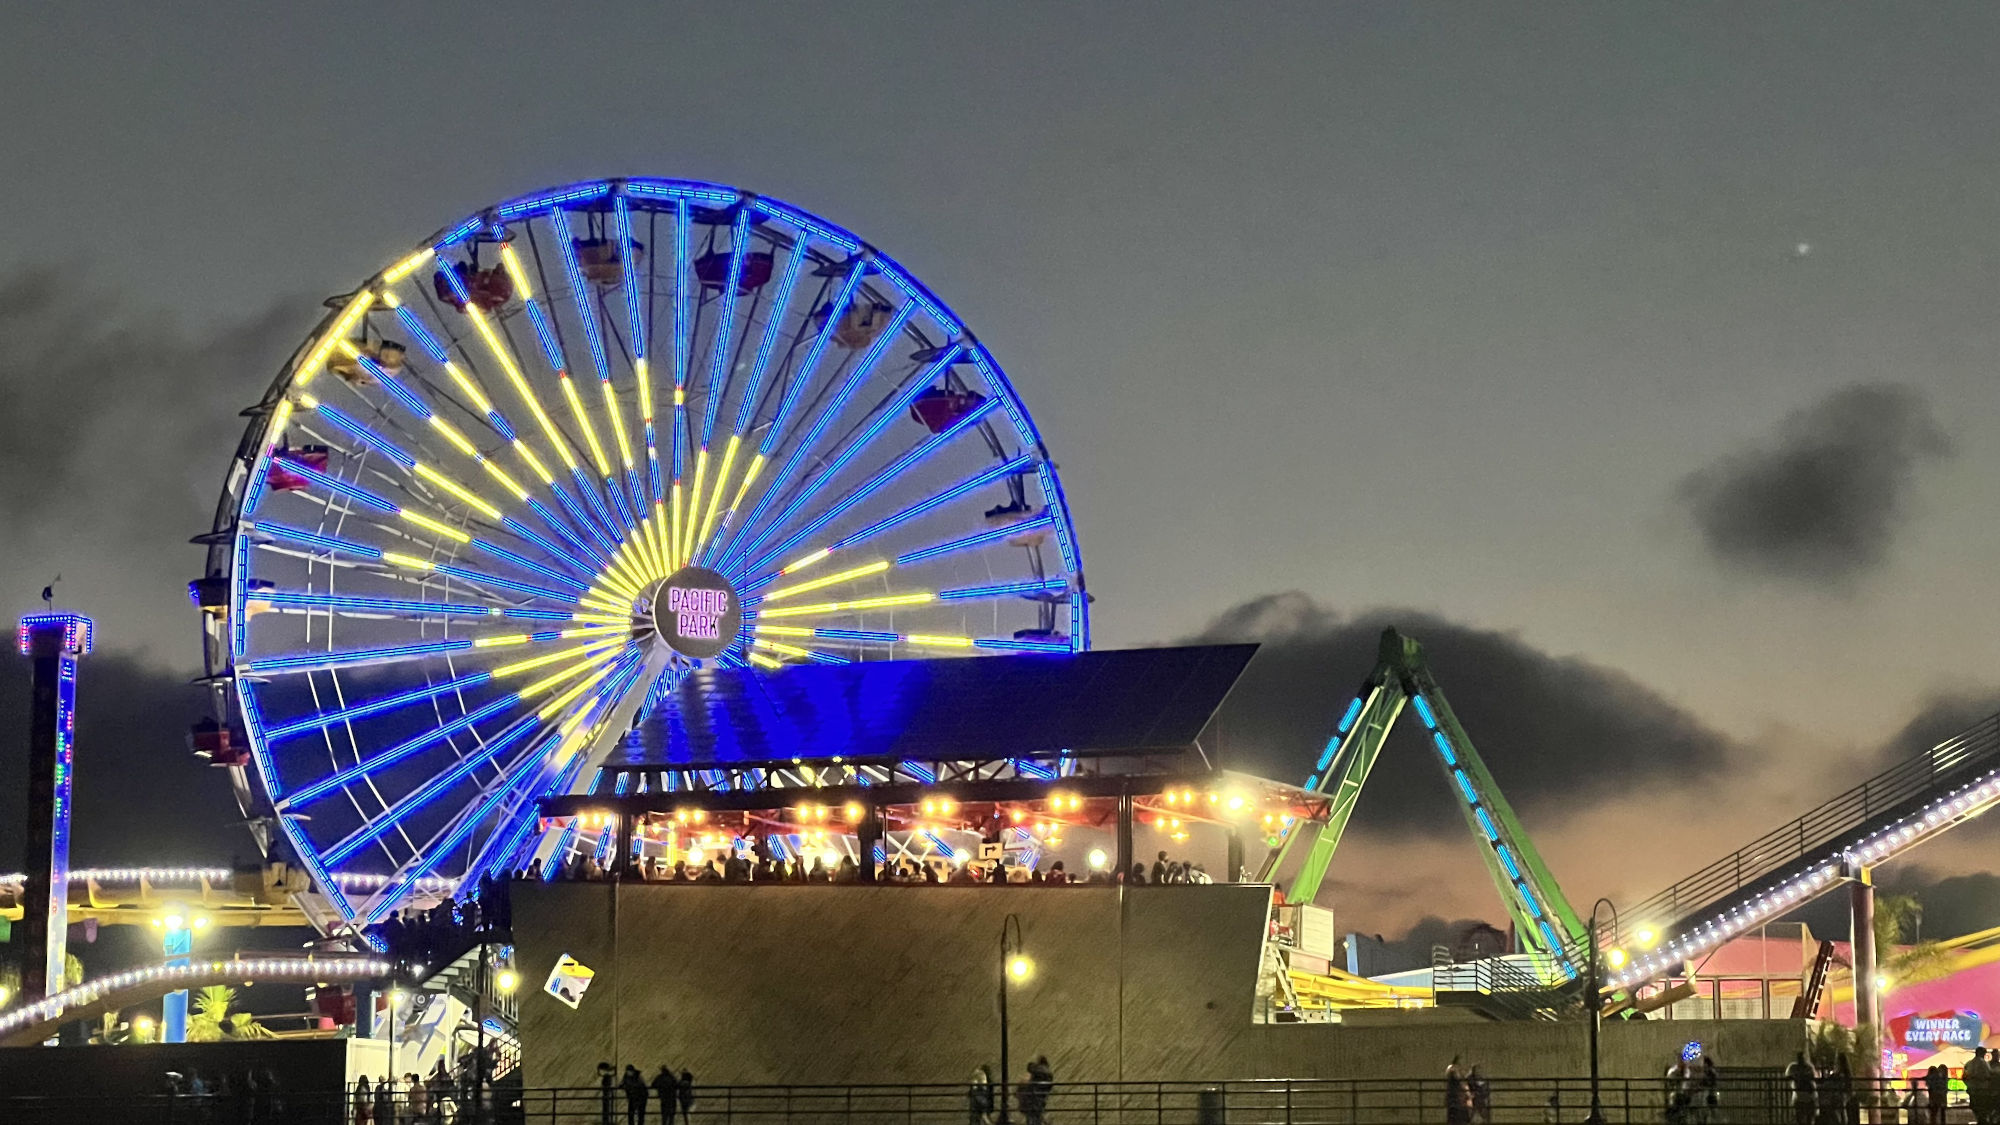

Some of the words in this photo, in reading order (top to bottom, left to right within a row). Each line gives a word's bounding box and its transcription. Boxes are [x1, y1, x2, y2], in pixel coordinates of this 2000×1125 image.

[669, 587, 728, 615] PACIFIC
[678, 612, 718, 638] PARK
[1915, 1018, 1960, 1030] WINNER
[1905, 1030, 1940, 1041] EVERY
[1942, 1030, 1972, 1041] RACE
